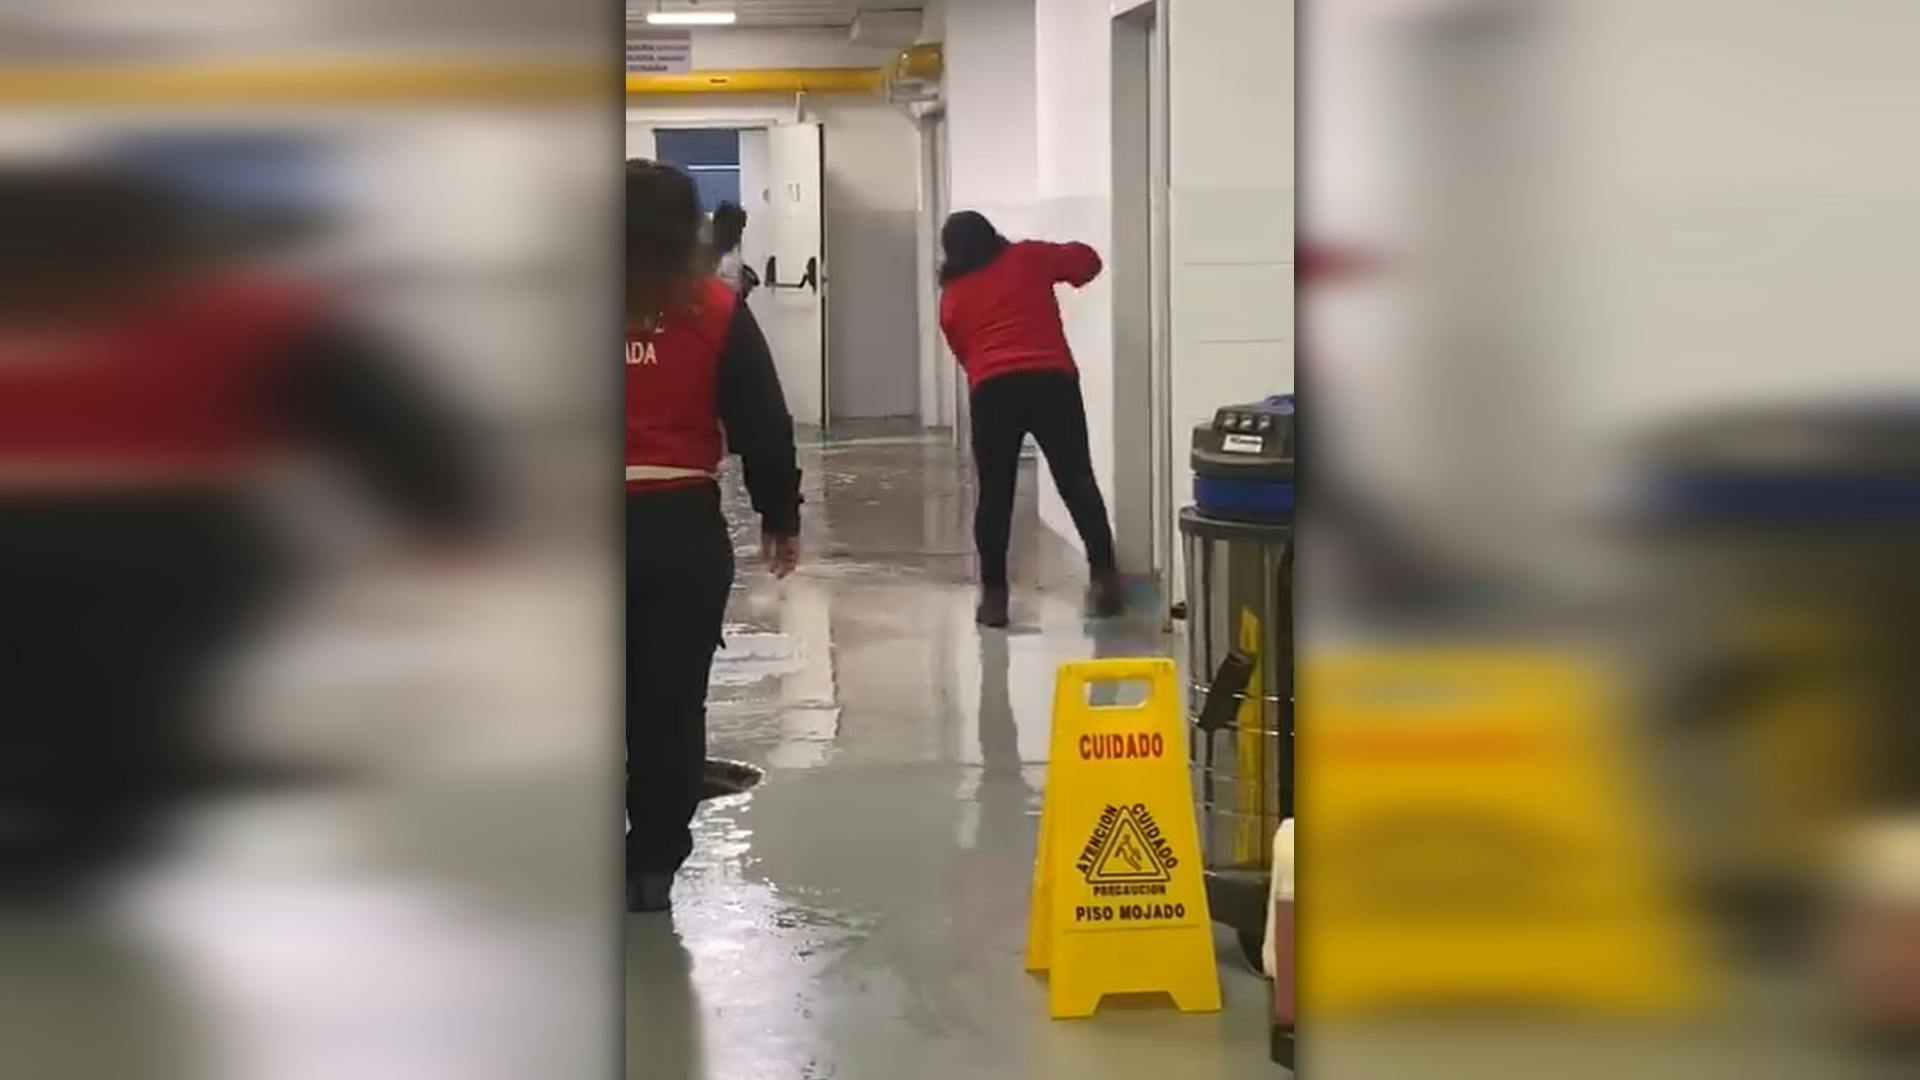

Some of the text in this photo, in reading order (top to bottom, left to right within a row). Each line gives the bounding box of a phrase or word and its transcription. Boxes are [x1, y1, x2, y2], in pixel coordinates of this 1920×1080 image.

[1079, 732, 1164, 760] CUIDADO
[1076, 804, 1118, 874] ATENCION
[1132, 803, 1179, 869] CUIDADO
[1093, 884, 1167, 897] PRECAUCION
[1075, 902, 1186, 921] PISO MOJADO
